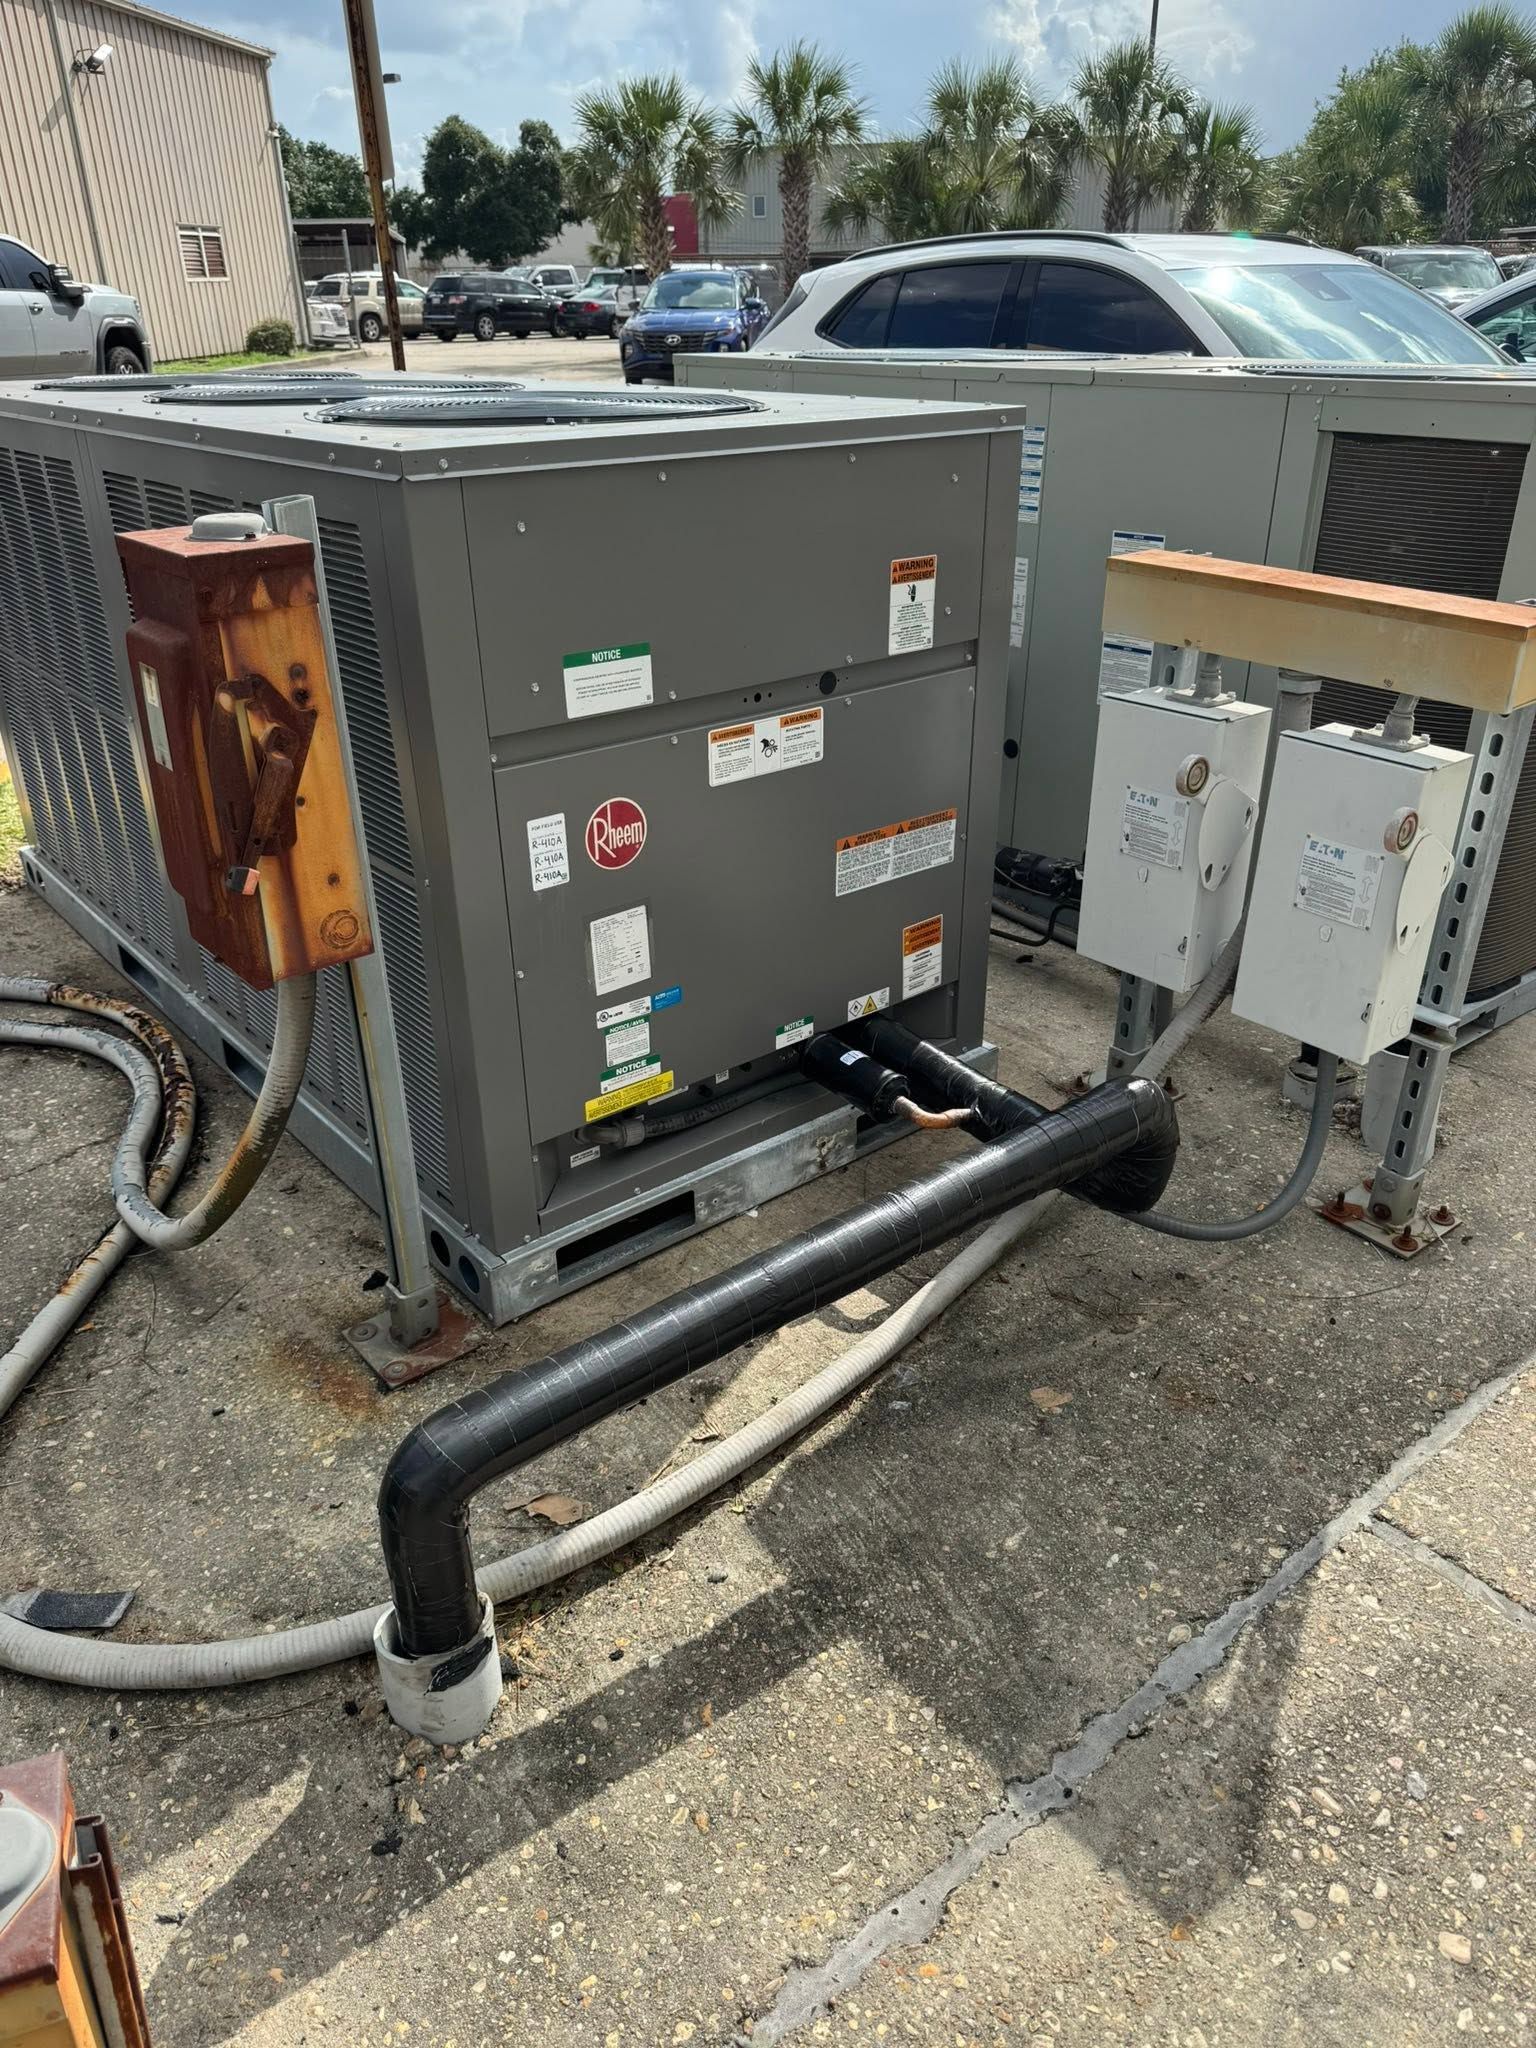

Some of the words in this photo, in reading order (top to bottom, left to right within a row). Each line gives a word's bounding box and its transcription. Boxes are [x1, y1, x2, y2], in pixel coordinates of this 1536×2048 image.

[899, 558, 934, 572] WARNING
[592, 649, 621, 662] NOTICE
[789, 711, 818, 725] WARNING
[592, 803, 643, 861] Rheem
[532, 836, 563, 850] R-410A
[534, 852, 565, 868] R-410A
[535, 870, 562, 884] R-410A
[784, 1019, 804, 1032] NOTICE
[616, 1059, 647, 1075] NOTICE
